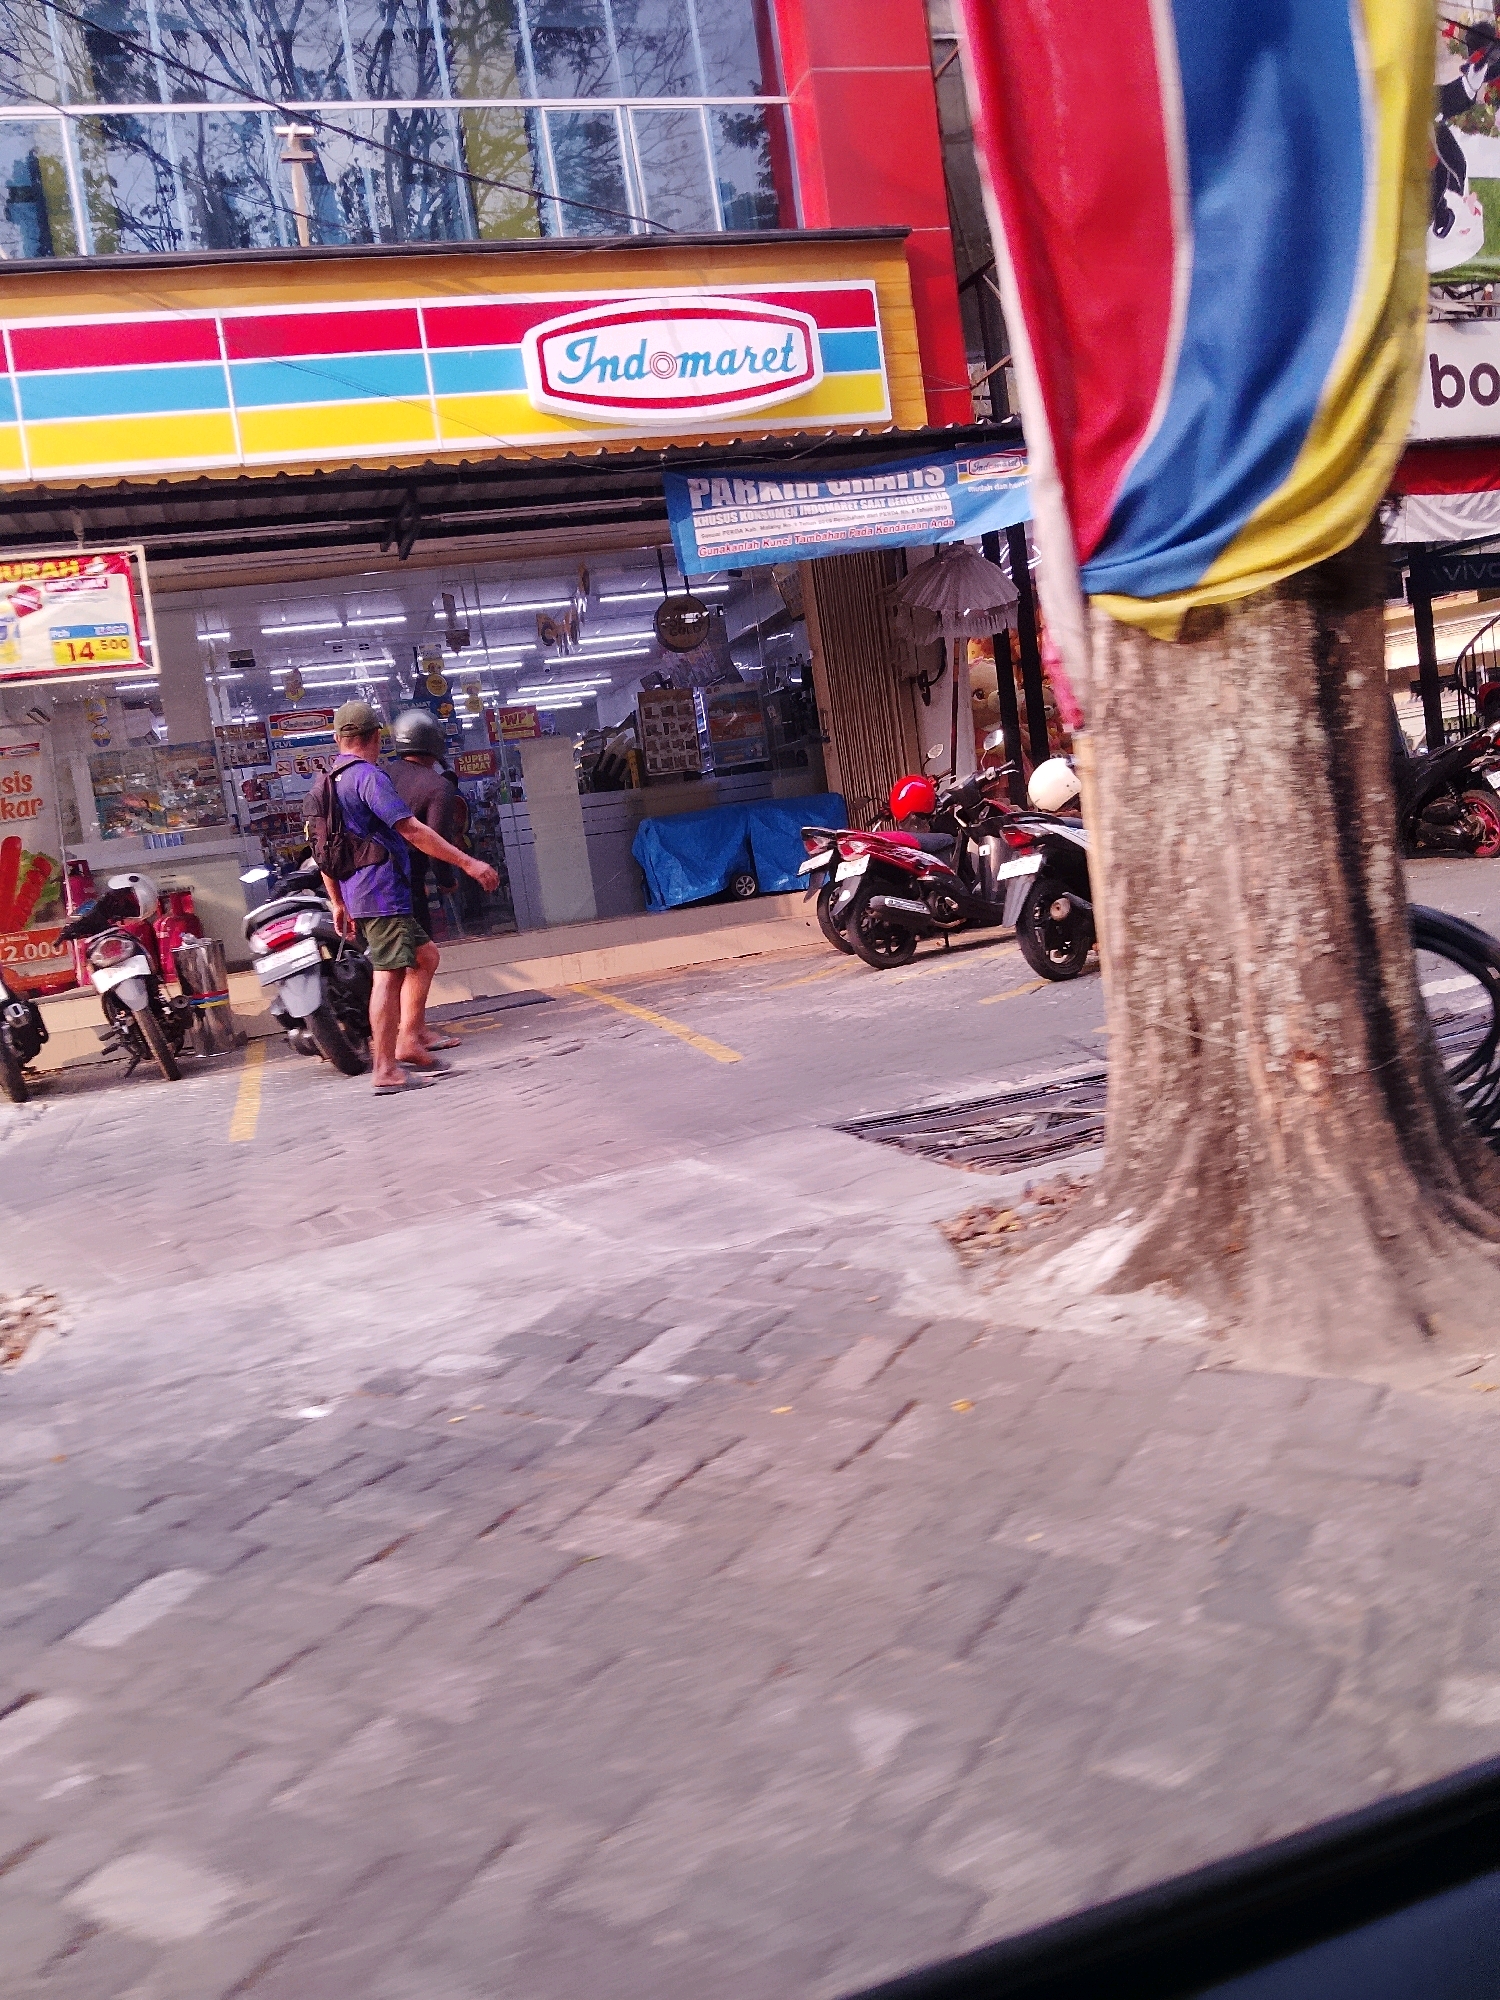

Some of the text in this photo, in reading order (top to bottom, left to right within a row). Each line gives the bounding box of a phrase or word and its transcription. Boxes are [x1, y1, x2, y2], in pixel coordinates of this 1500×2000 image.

[557, 332, 798, 385] Indomaret
[1429, 353, 1500, 408] bo
[693, 512, 738, 528] KHUSUS
[740, 505, 798, 522] KONSUMEN
[799, 500, 859, 516] INDOMARET
[860, 497, 886, 510] SAAT
[698, 517, 956, 558] Gunakanlah Kunci Tambahan Pada Kendaraan Anda
[0, 560, 80, 582] URAH
[459, 753, 491, 765] SUPER
[459, 761, 492, 772] HEMAT
[0, 941, 64, 962] 2.000
